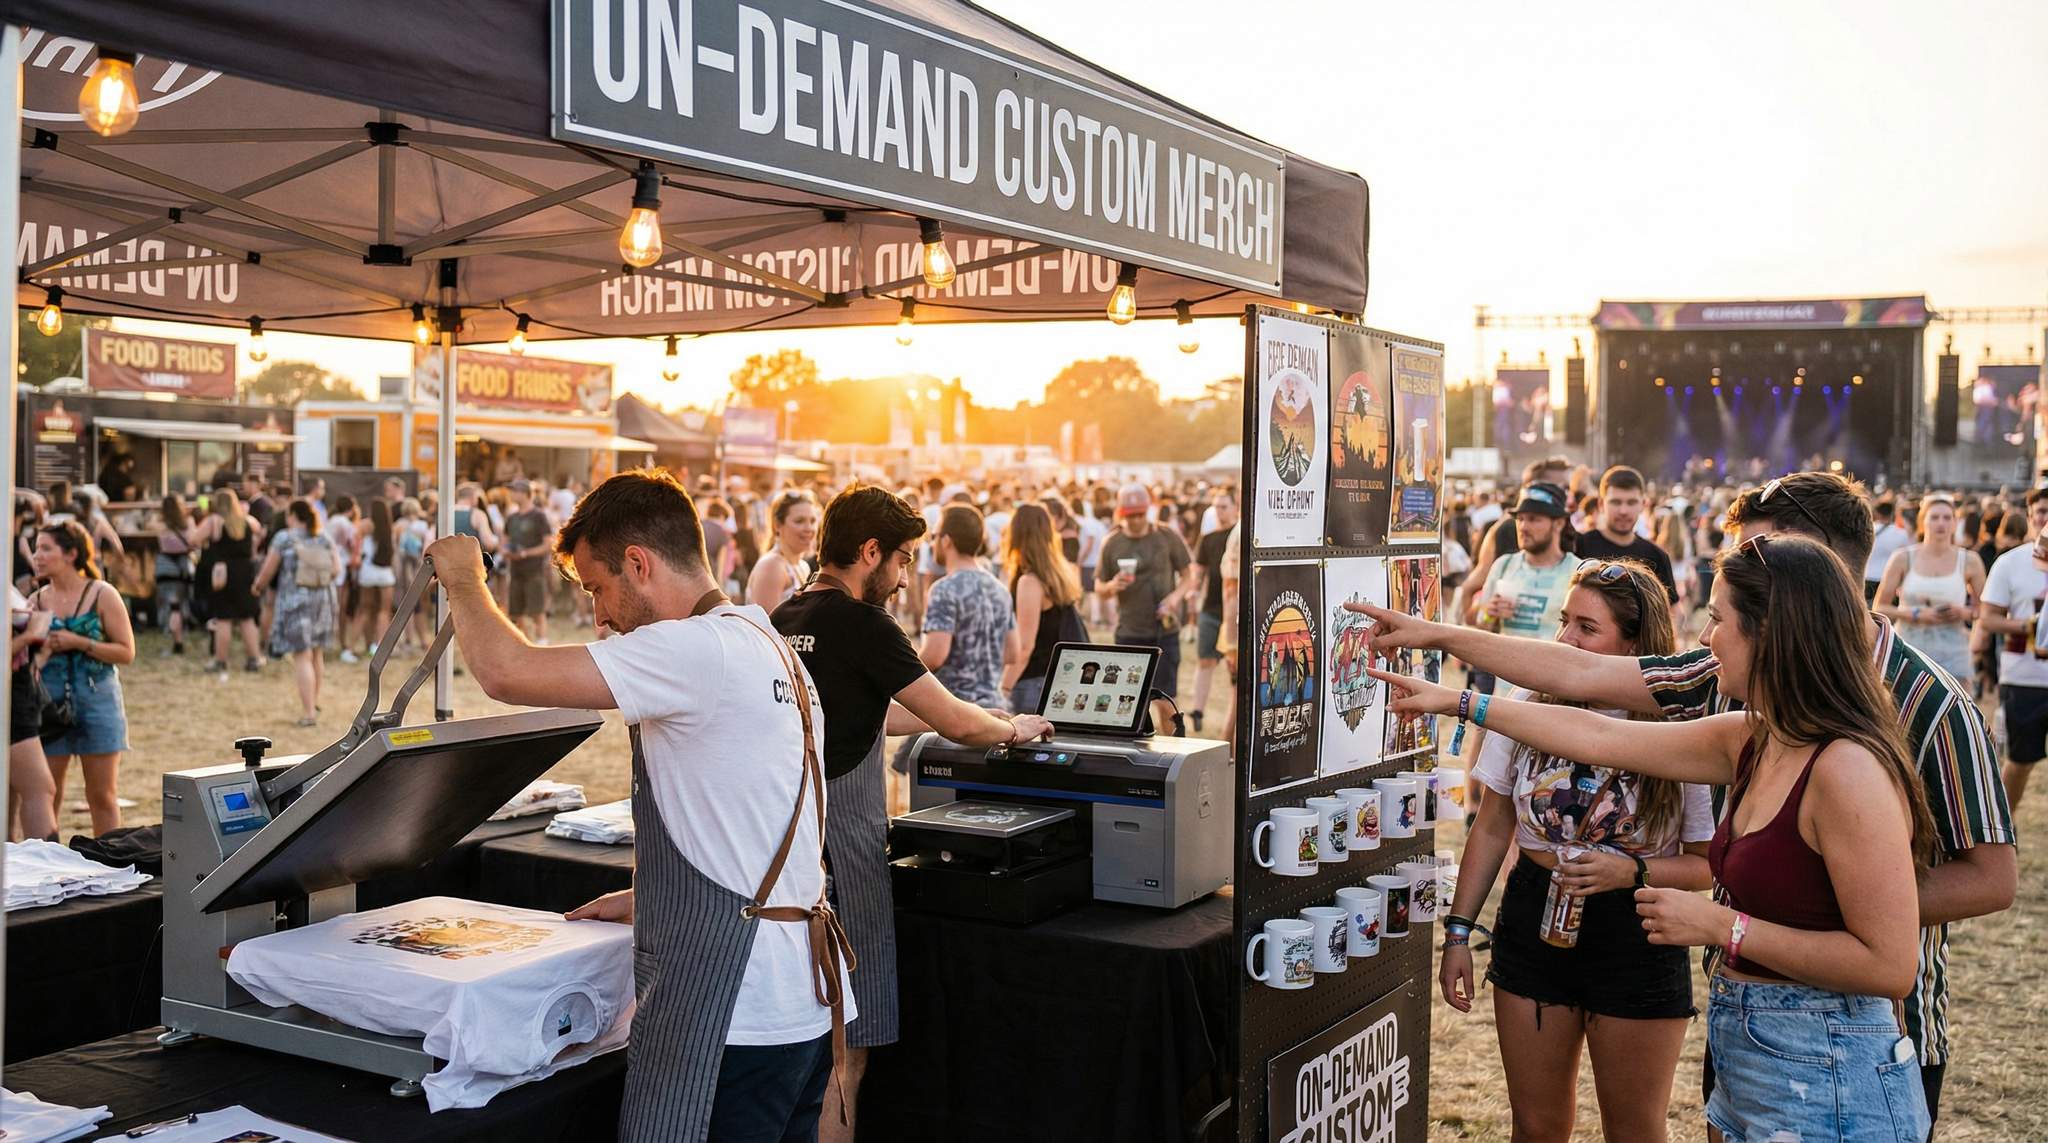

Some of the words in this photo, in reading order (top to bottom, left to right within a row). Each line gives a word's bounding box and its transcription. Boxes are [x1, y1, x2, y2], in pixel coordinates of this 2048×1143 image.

[592, 0, 978, 187] ON-DEMAND
[994, 88, 1158, 233] CUSTOM
[1168, 151, 1275, 265] MERCH
[100, 336, 159, 369] FOOD
[458, 362, 510, 398] FOOD
[1299, 1019, 1395, 1122] ON-DEMAND
[1300, 1073, 1393, 1143] STOM
